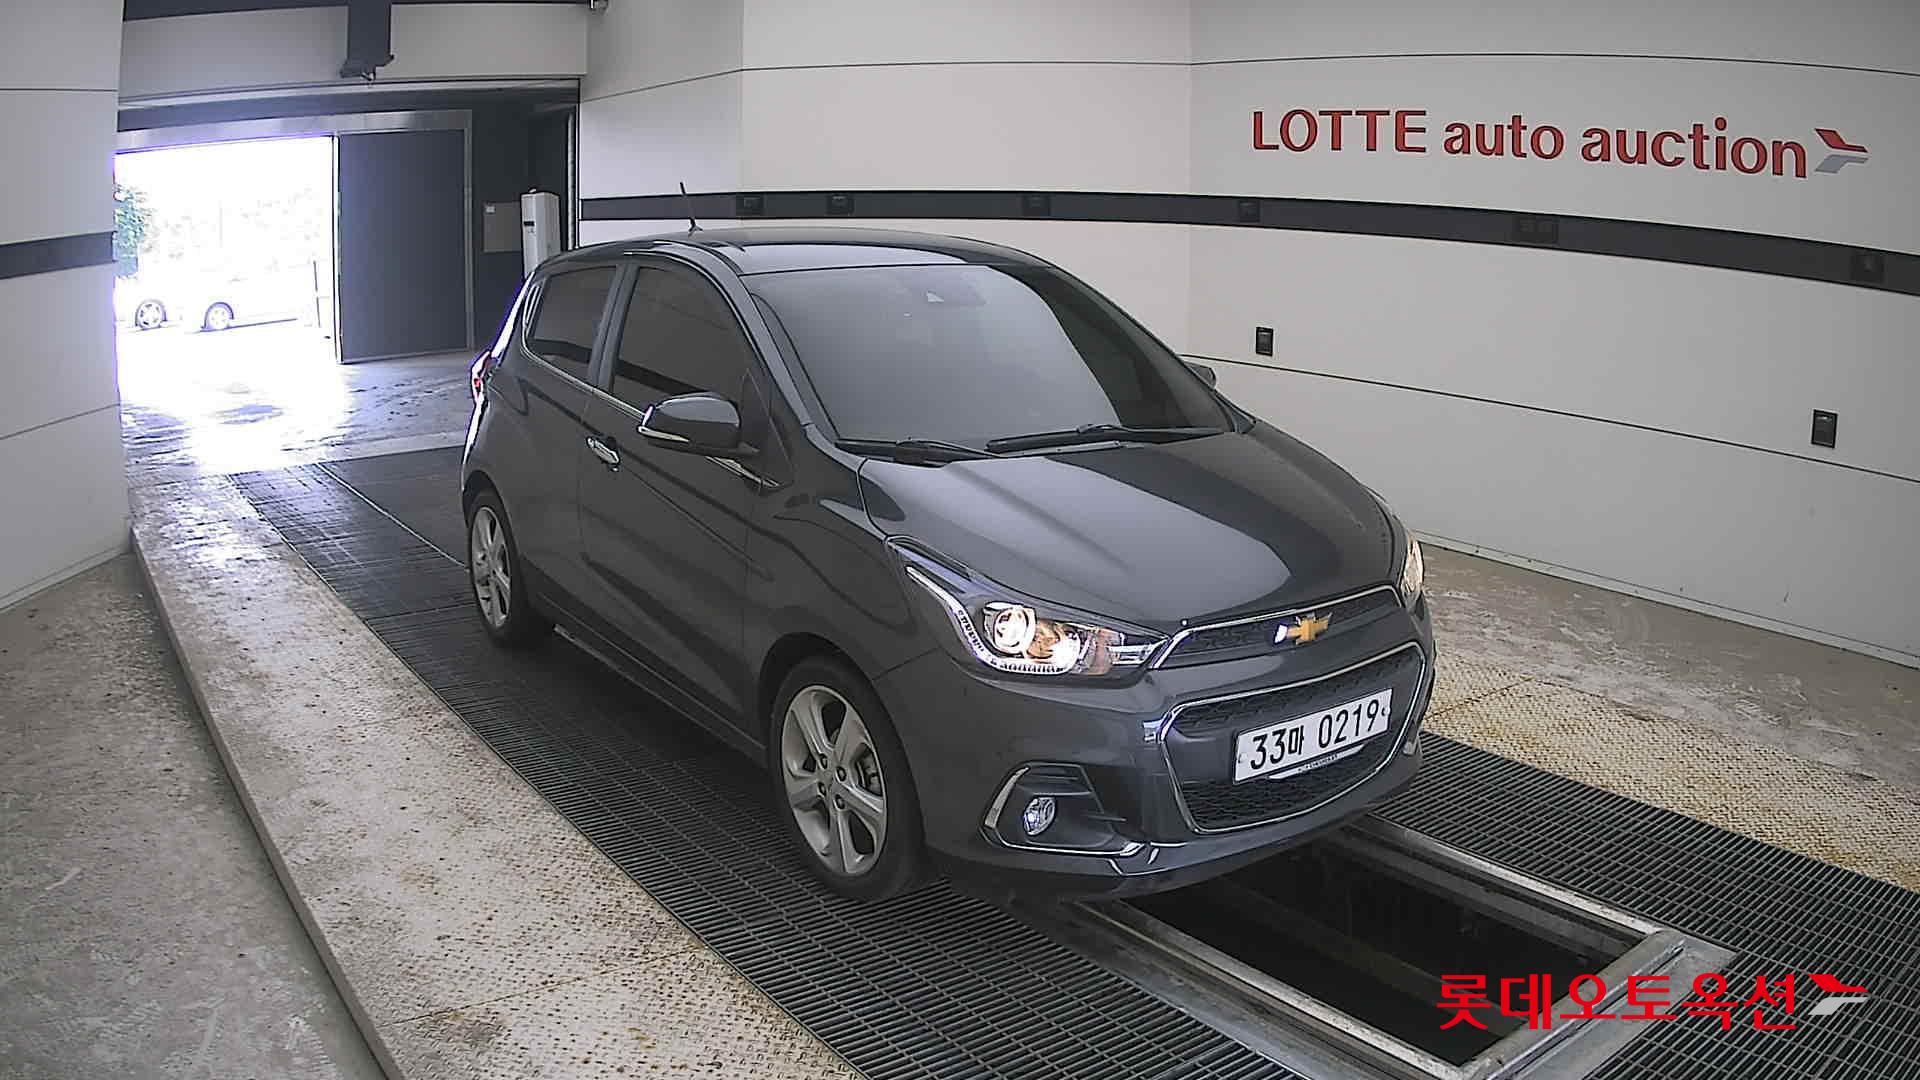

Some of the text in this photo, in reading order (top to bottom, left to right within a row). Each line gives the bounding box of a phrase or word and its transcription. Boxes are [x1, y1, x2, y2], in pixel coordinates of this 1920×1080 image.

[1252, 109, 1807, 178] LOTTE auto auction
[1250, 725, 1304, 770] 33마
[1318, 699, 1380, 749] 0219
